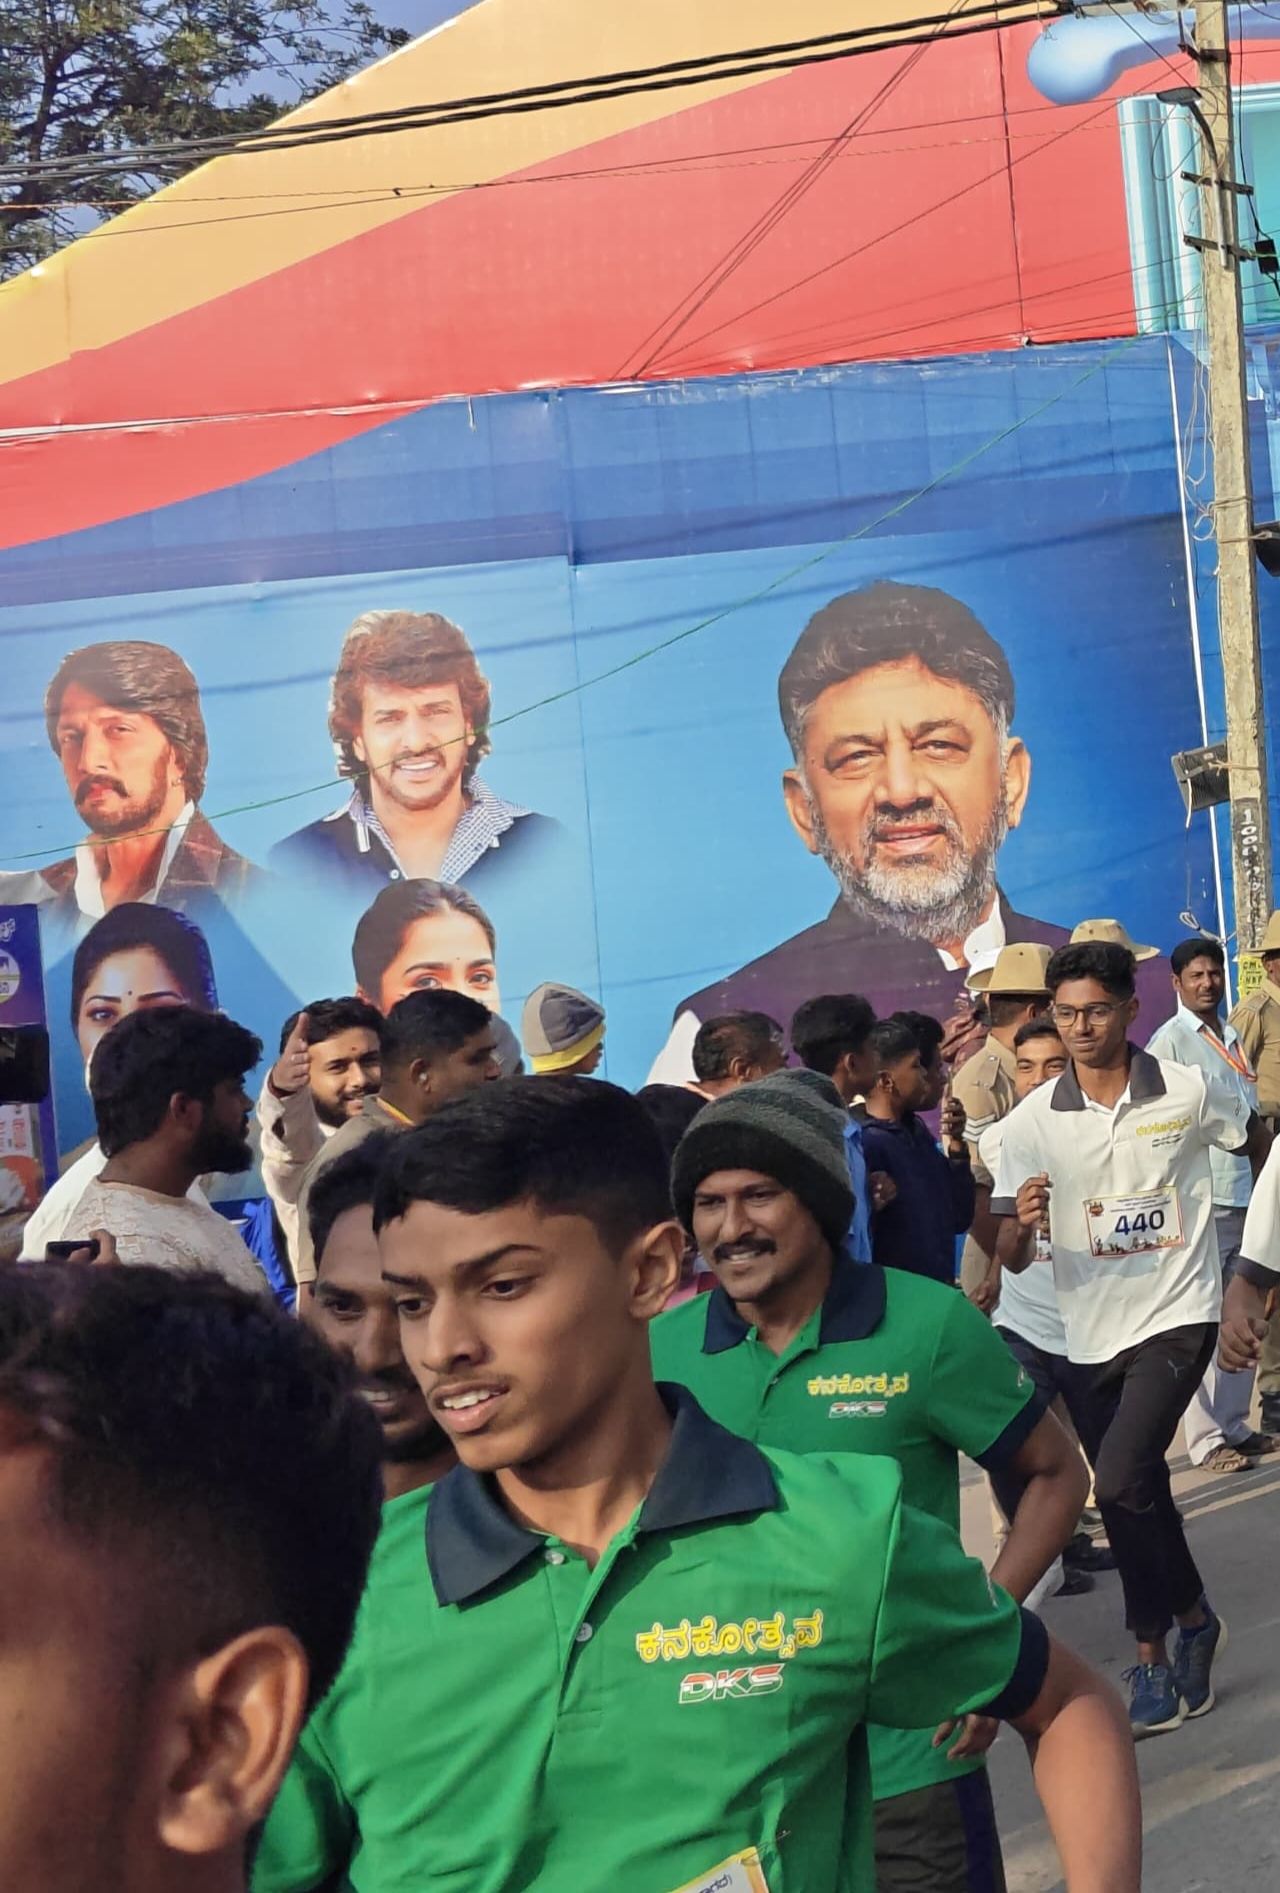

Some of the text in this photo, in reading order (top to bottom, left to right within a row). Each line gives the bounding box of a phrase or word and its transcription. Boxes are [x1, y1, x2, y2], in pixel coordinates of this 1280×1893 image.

[1114, 1209, 1165, 1235] 440
[636, 1608, 824, 1663] ಕನಕೋತ್ಸವ
[678, 1662, 786, 1705] DKS
